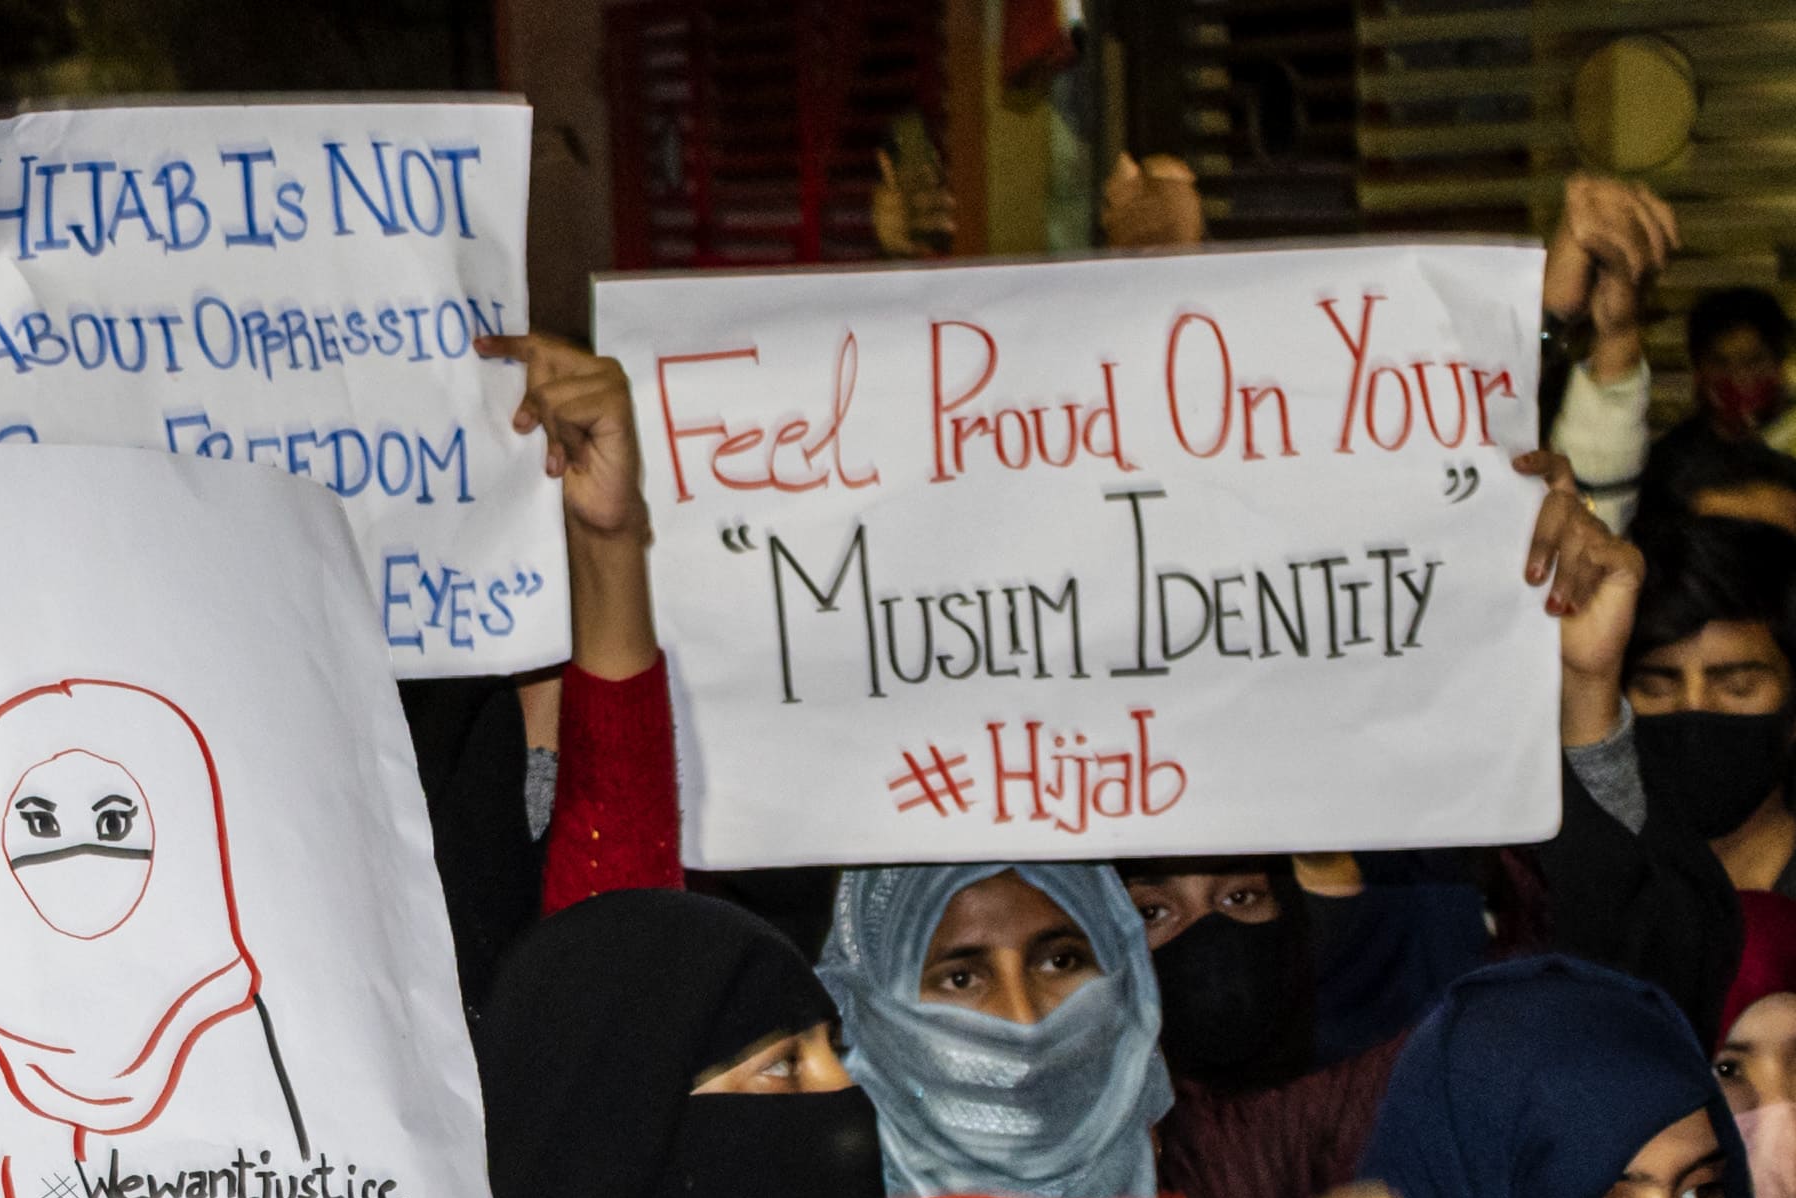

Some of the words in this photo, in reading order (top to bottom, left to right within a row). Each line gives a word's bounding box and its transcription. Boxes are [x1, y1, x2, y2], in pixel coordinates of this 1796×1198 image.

[322, 141, 481, 240] NOT
[657, 331, 880, 503] Feel
[929, 318, 1141, 484] Proud
[1165, 312, 1299, 461] On
[888, 709, 1188, 834] #Hijab
